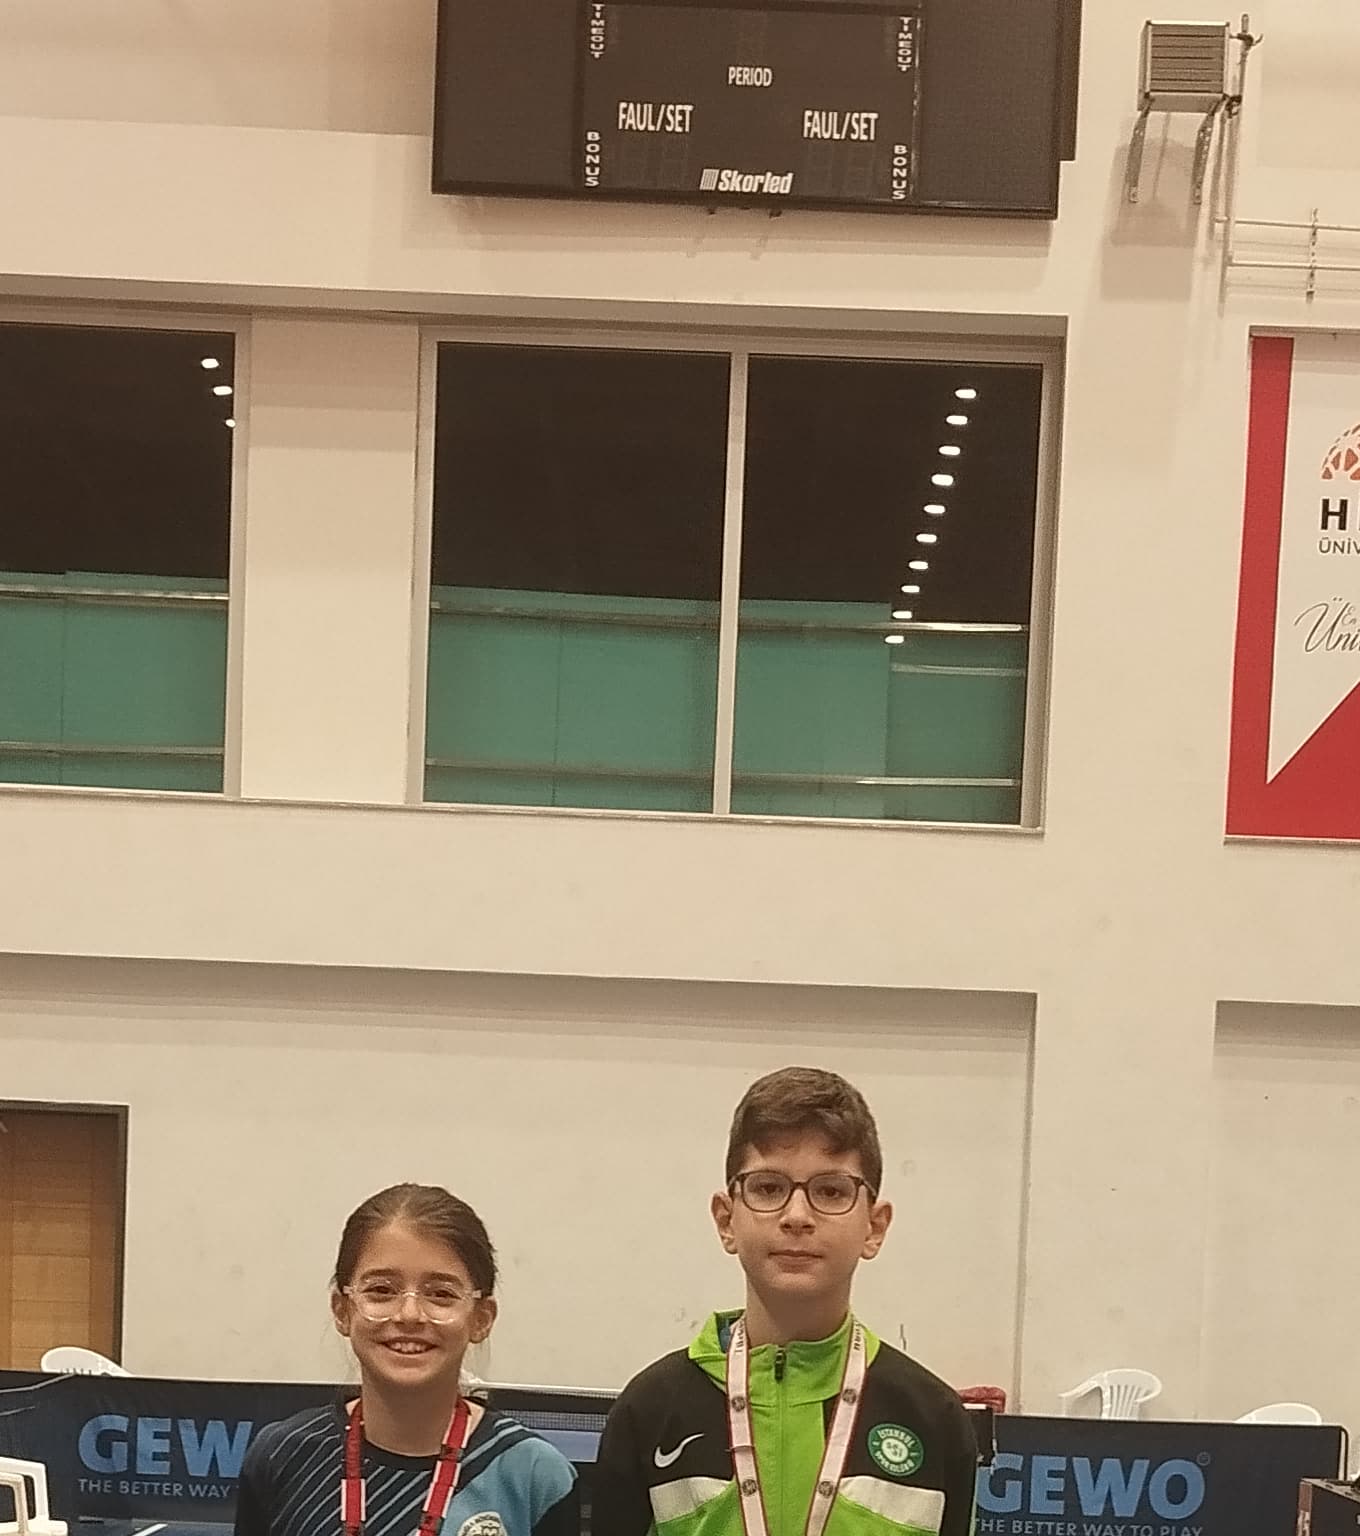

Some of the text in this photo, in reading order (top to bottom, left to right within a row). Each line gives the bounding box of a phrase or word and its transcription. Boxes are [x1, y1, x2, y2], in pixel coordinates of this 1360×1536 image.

[591, 3, 605, 58] TIMEOUT
[899, 16, 912, 71] TIMEOUT
[728, 66, 773, 88] PERIOD
[618, 102, 694, 133] FAUL/SET
[803, 109, 878, 141] FAUL/SET
[585, 131, 600, 187] BONUS
[892, 145, 907, 200] BONUS
[78, 1478, 230, 1498] THE BETTER WAY
[976, 1453, 1206, 1520] GEWO
[1012, 1519, 1077, 1536] BETTER
